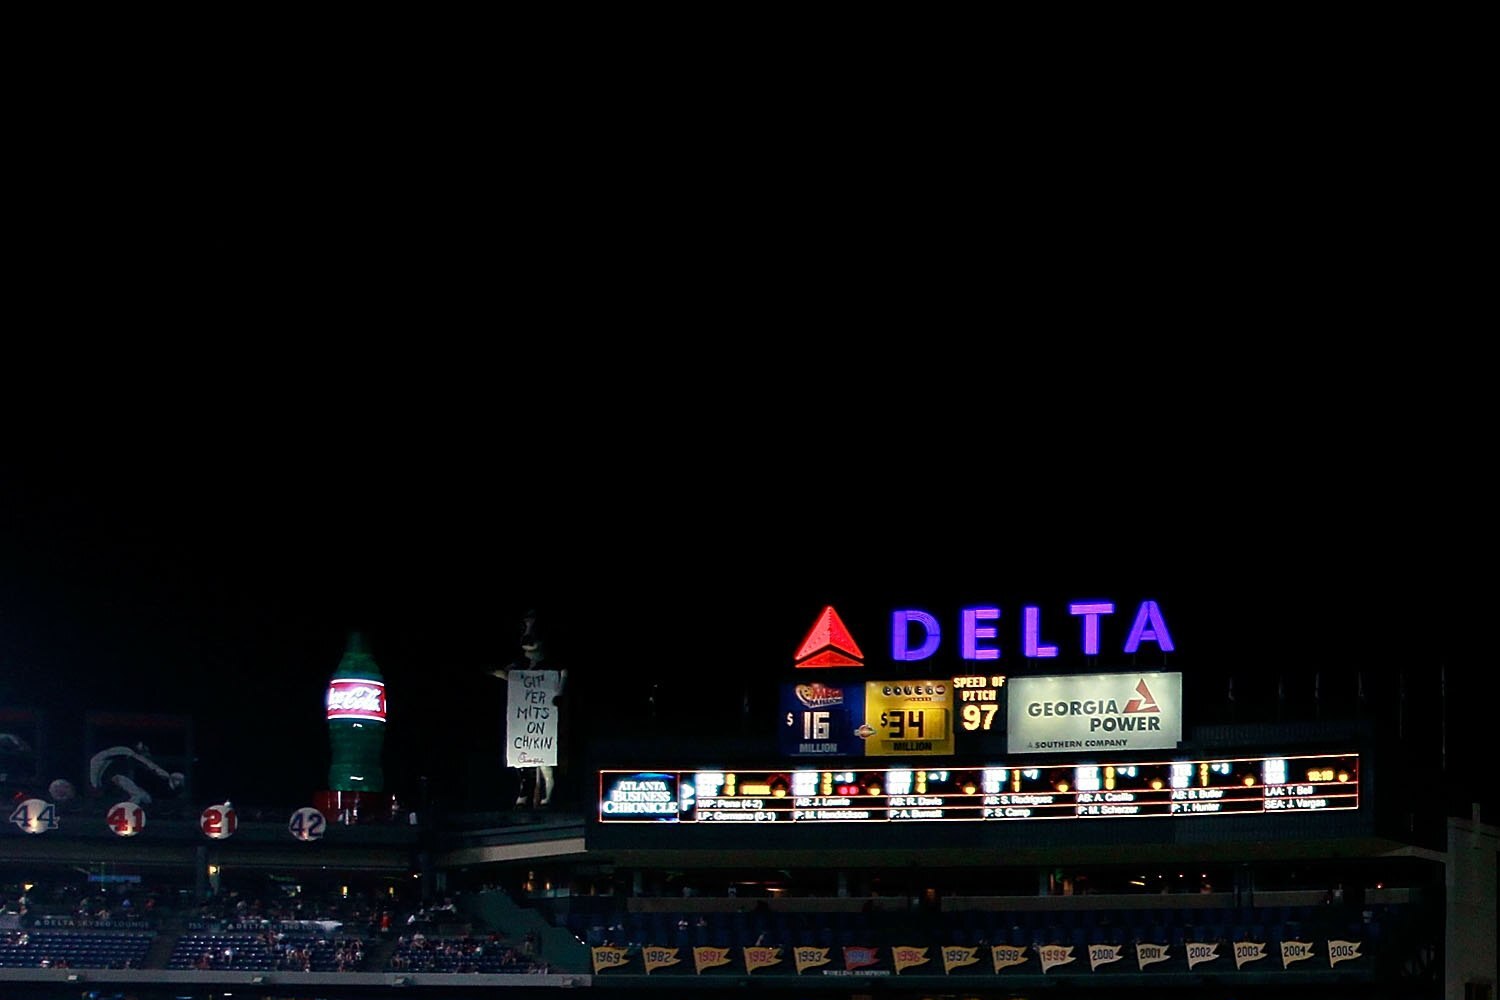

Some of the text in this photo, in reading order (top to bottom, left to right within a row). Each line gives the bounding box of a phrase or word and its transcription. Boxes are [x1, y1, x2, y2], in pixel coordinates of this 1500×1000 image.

[892, 600, 1175, 661] DELTA
[954, 676, 1005, 689] SPEED OF
[962, 689, 997, 702] PITCH
[517, 706, 550, 719] MITS
[1027, 700, 1119, 718] GEORGIA
[962, 704, 999, 731] 97
[1090, 716, 1161, 732] POWER
[527, 721, 545, 735] ON
[804, 711, 830, 740] 16
[889, 711, 925, 738] 34
[799, 743, 838, 752] MILLION
[893, 742, 932, 751] MILLION
[1035, 738, 1128, 749] SOUTHERN COMPANY
[618, 780, 667, 791] ATLANTA
[611, 790, 671, 802] BUSINESS
[602, 801, 679, 814] CHRONICLE
[9, 803, 60, 830] 44
[106, 806, 145, 833] 41
[202, 808, 237, 834] 21
[289, 812, 325, 838] 42
[595, 951, 621, 964] 1969
[646, 951, 672, 963] 1982
[945, 950, 970, 962] 1997
[1041, 950, 1067, 961] 1999
[1091, 949, 1114, 961] 2000
[1139, 948, 1162, 959] 2001
[1189, 947, 1212, 959] 2002
[1236, 946, 1260, 958] 2003
[1283, 945, 1307, 957] 2004
[1331, 945, 1354, 957] 2005
